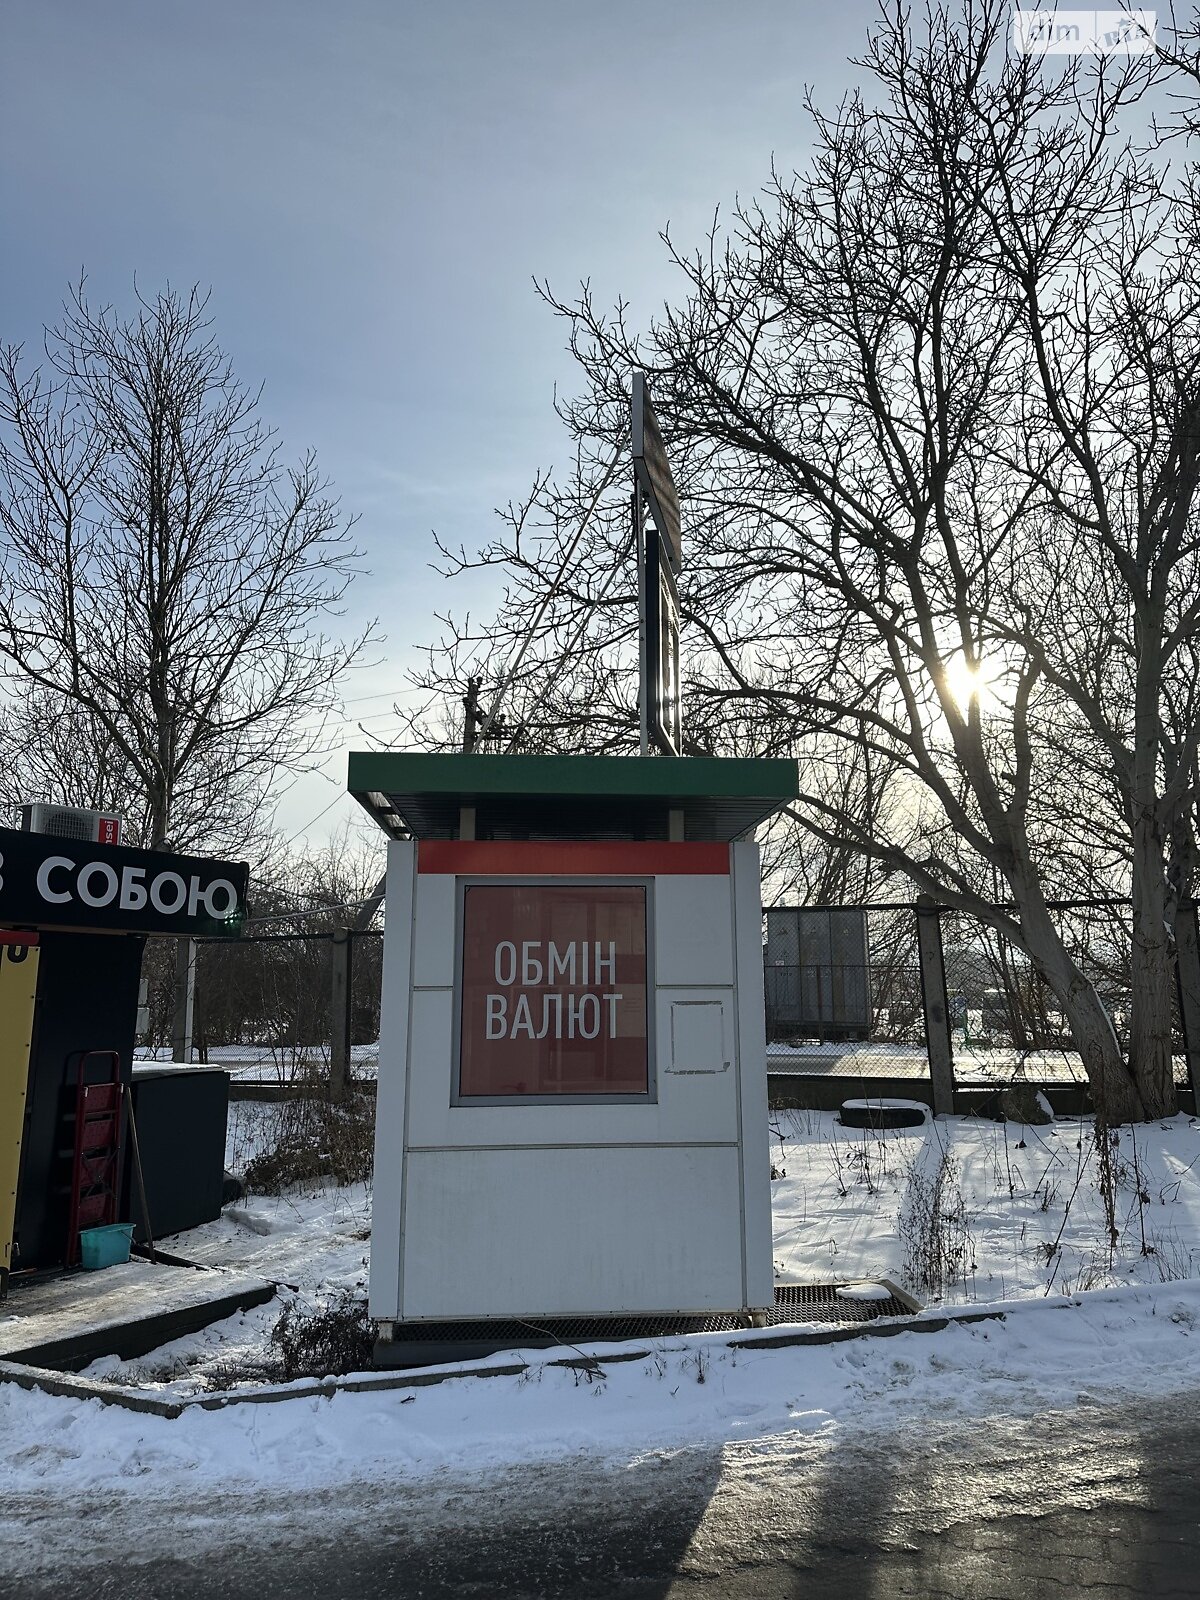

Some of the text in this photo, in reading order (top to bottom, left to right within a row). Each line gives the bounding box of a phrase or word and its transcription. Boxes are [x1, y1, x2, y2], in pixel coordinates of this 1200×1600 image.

[36, 856, 238, 920] СОБОЮ
[494, 941, 616, 986] ОБМІН
[485, 993, 623, 1040] ВАЛЮТ
